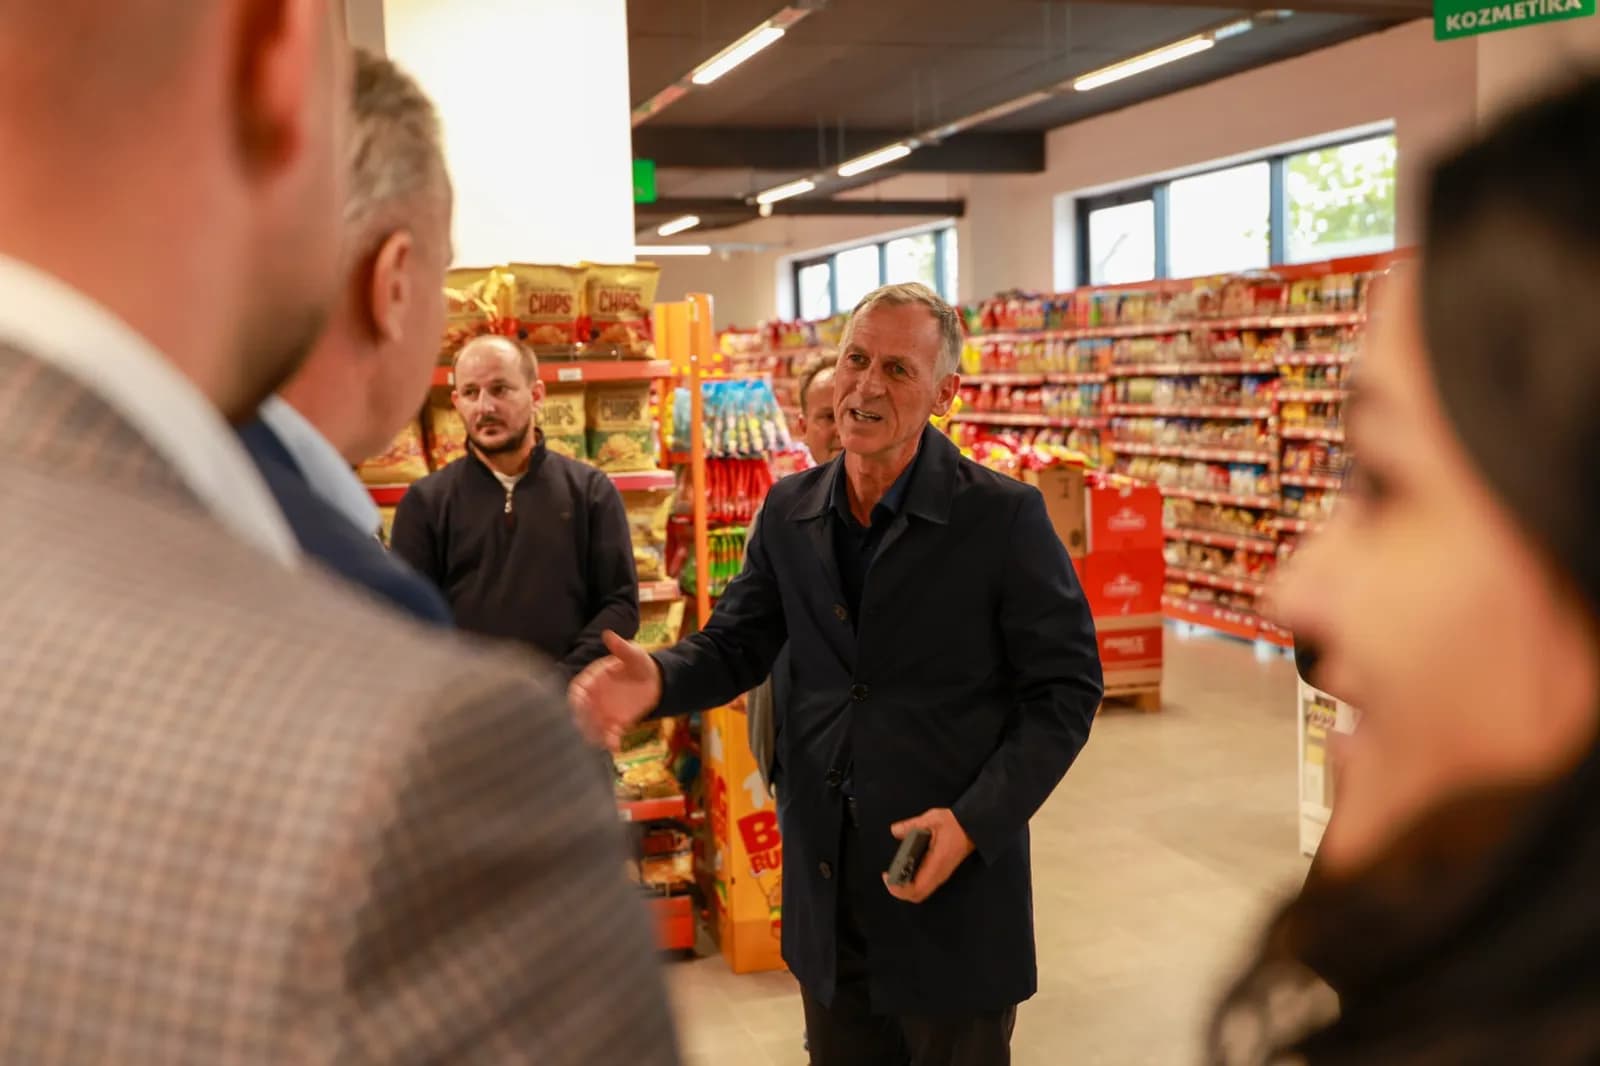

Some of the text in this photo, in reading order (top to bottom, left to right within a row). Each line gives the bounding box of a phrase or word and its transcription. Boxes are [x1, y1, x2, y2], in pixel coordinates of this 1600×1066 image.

[1446, 0, 1582, 32] KOZMETIKA
[529, 293, 572, 314] CHIPS
[599, 290, 641, 313] CHIPS
[601, 399, 641, 421] CHIPS
[738, 811, 781, 853] B
